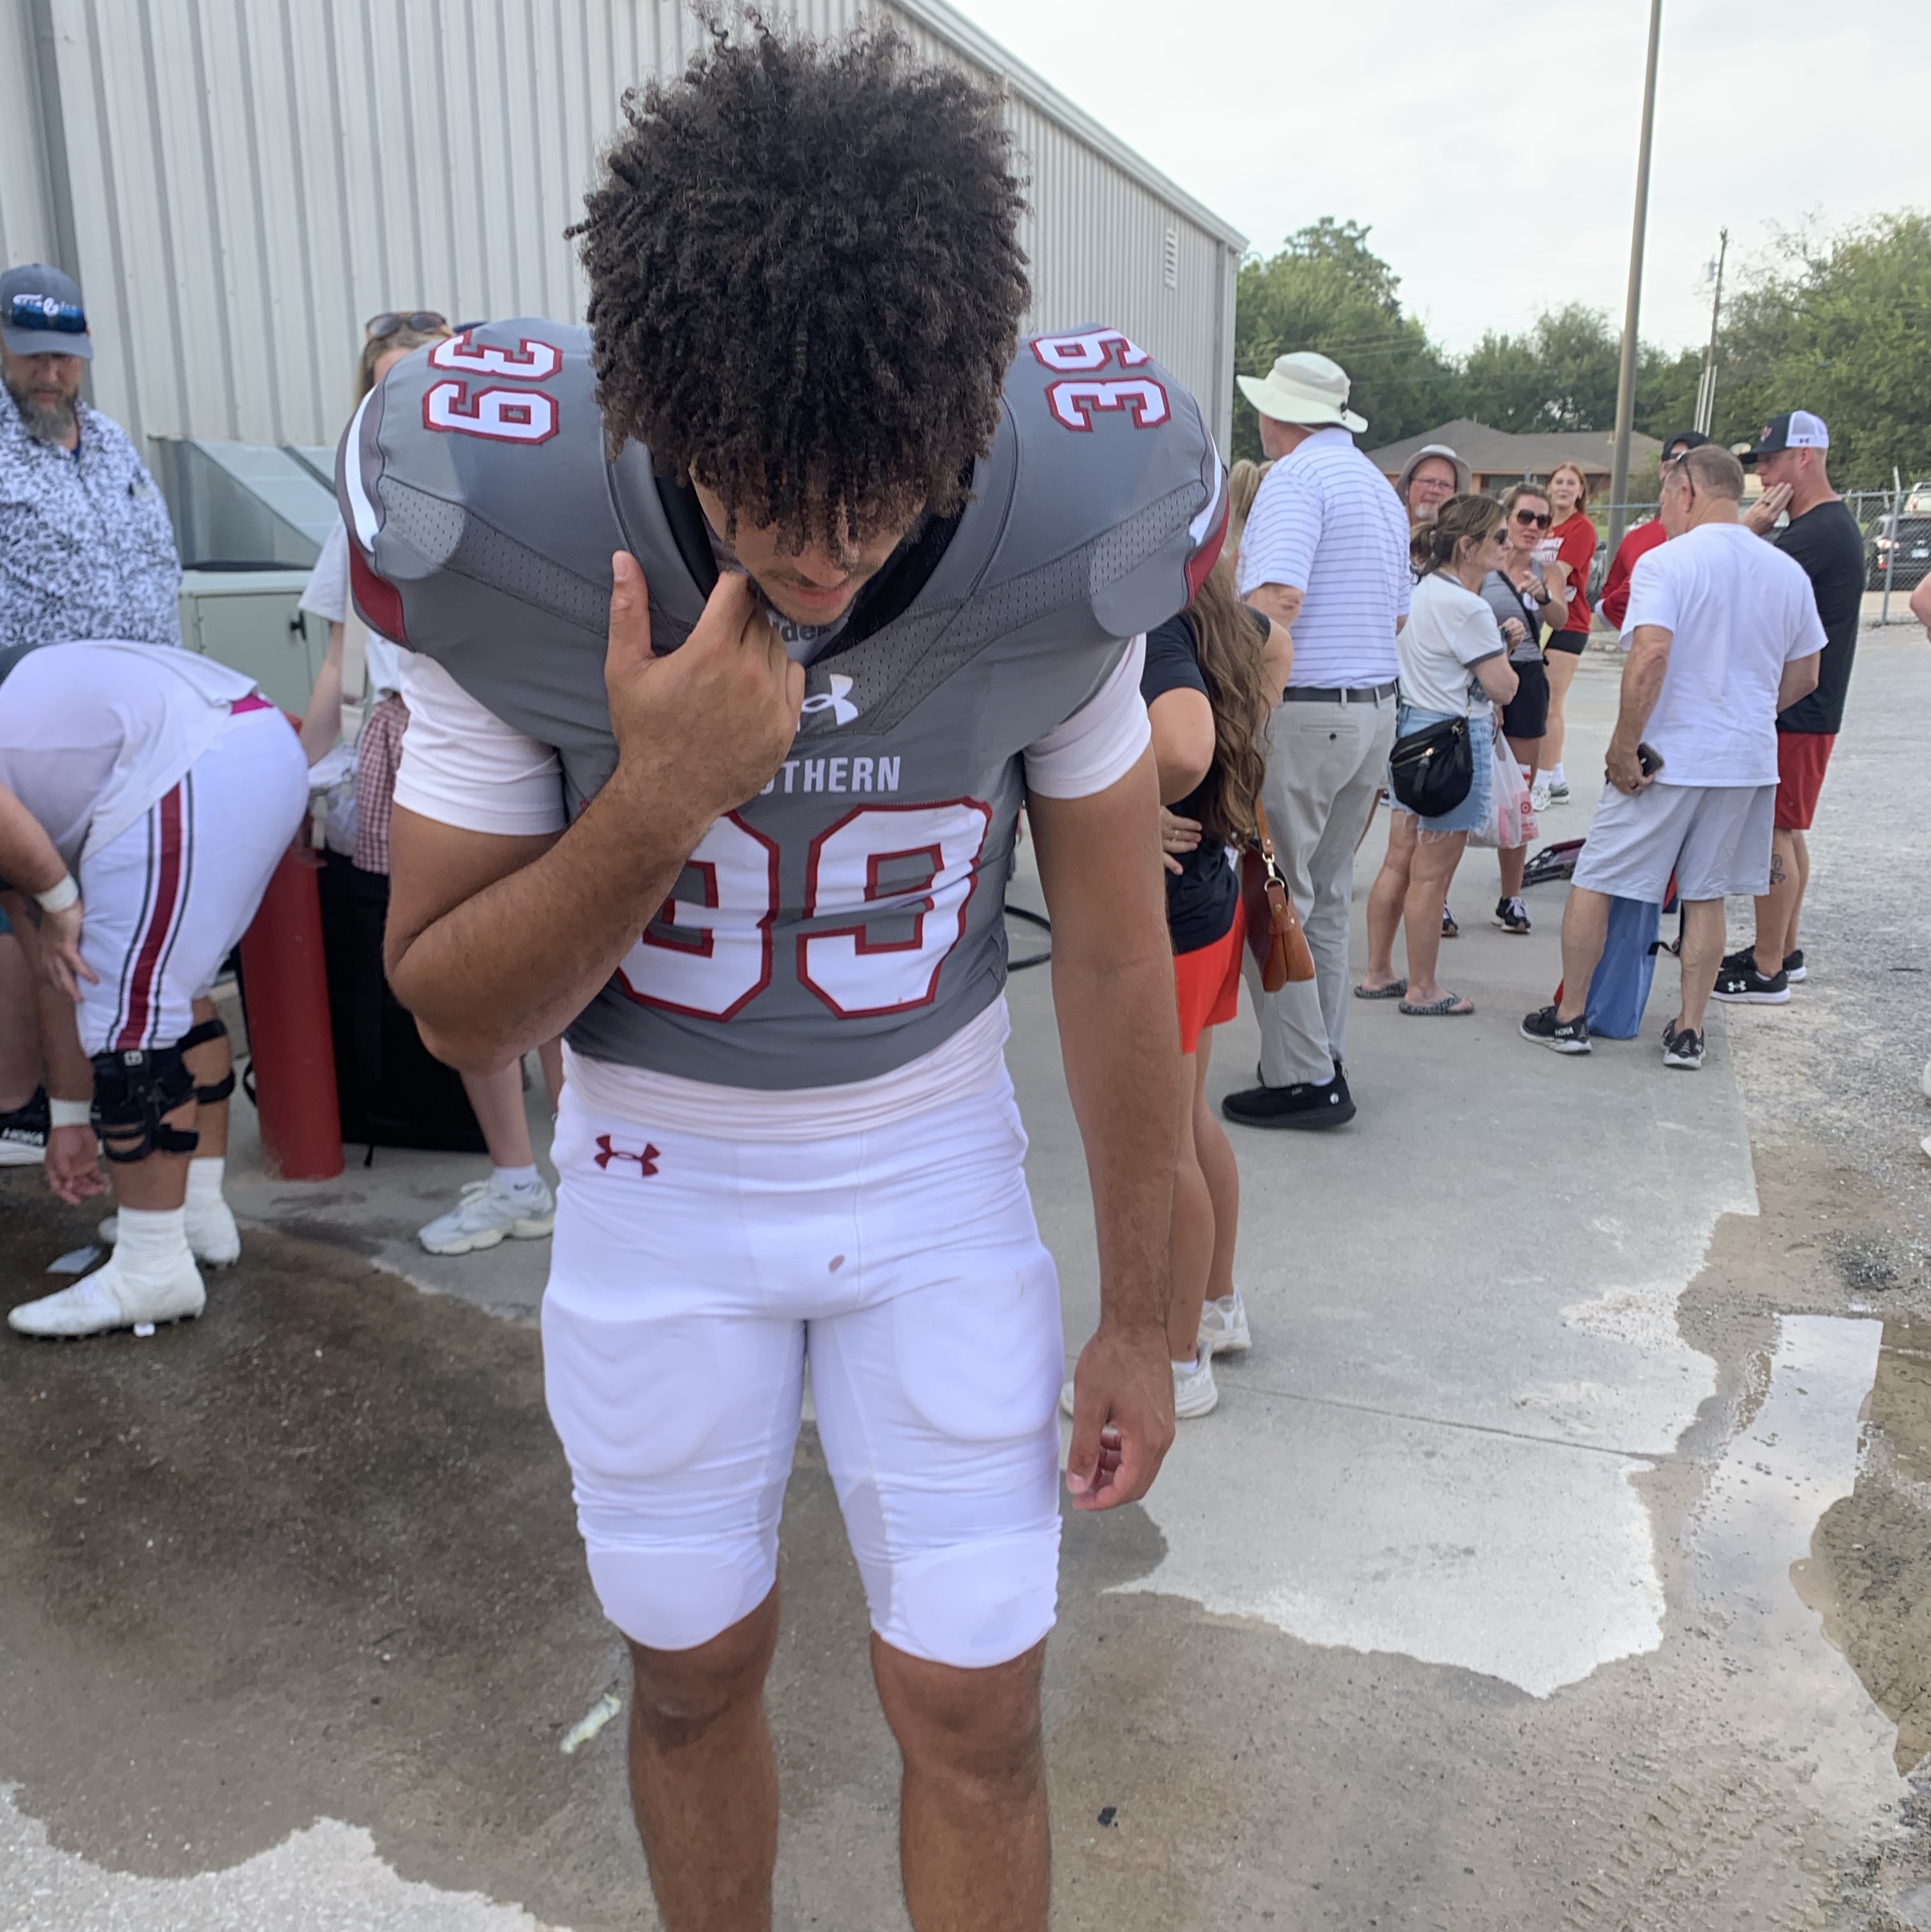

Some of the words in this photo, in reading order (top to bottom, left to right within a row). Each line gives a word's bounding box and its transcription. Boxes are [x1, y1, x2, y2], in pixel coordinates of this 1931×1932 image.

[422, 328, 564, 445] 39
[1028, 326, 1172, 434] 39
[760, 756, 901, 796] THERN
[614, 796, 993, 1023] 39
